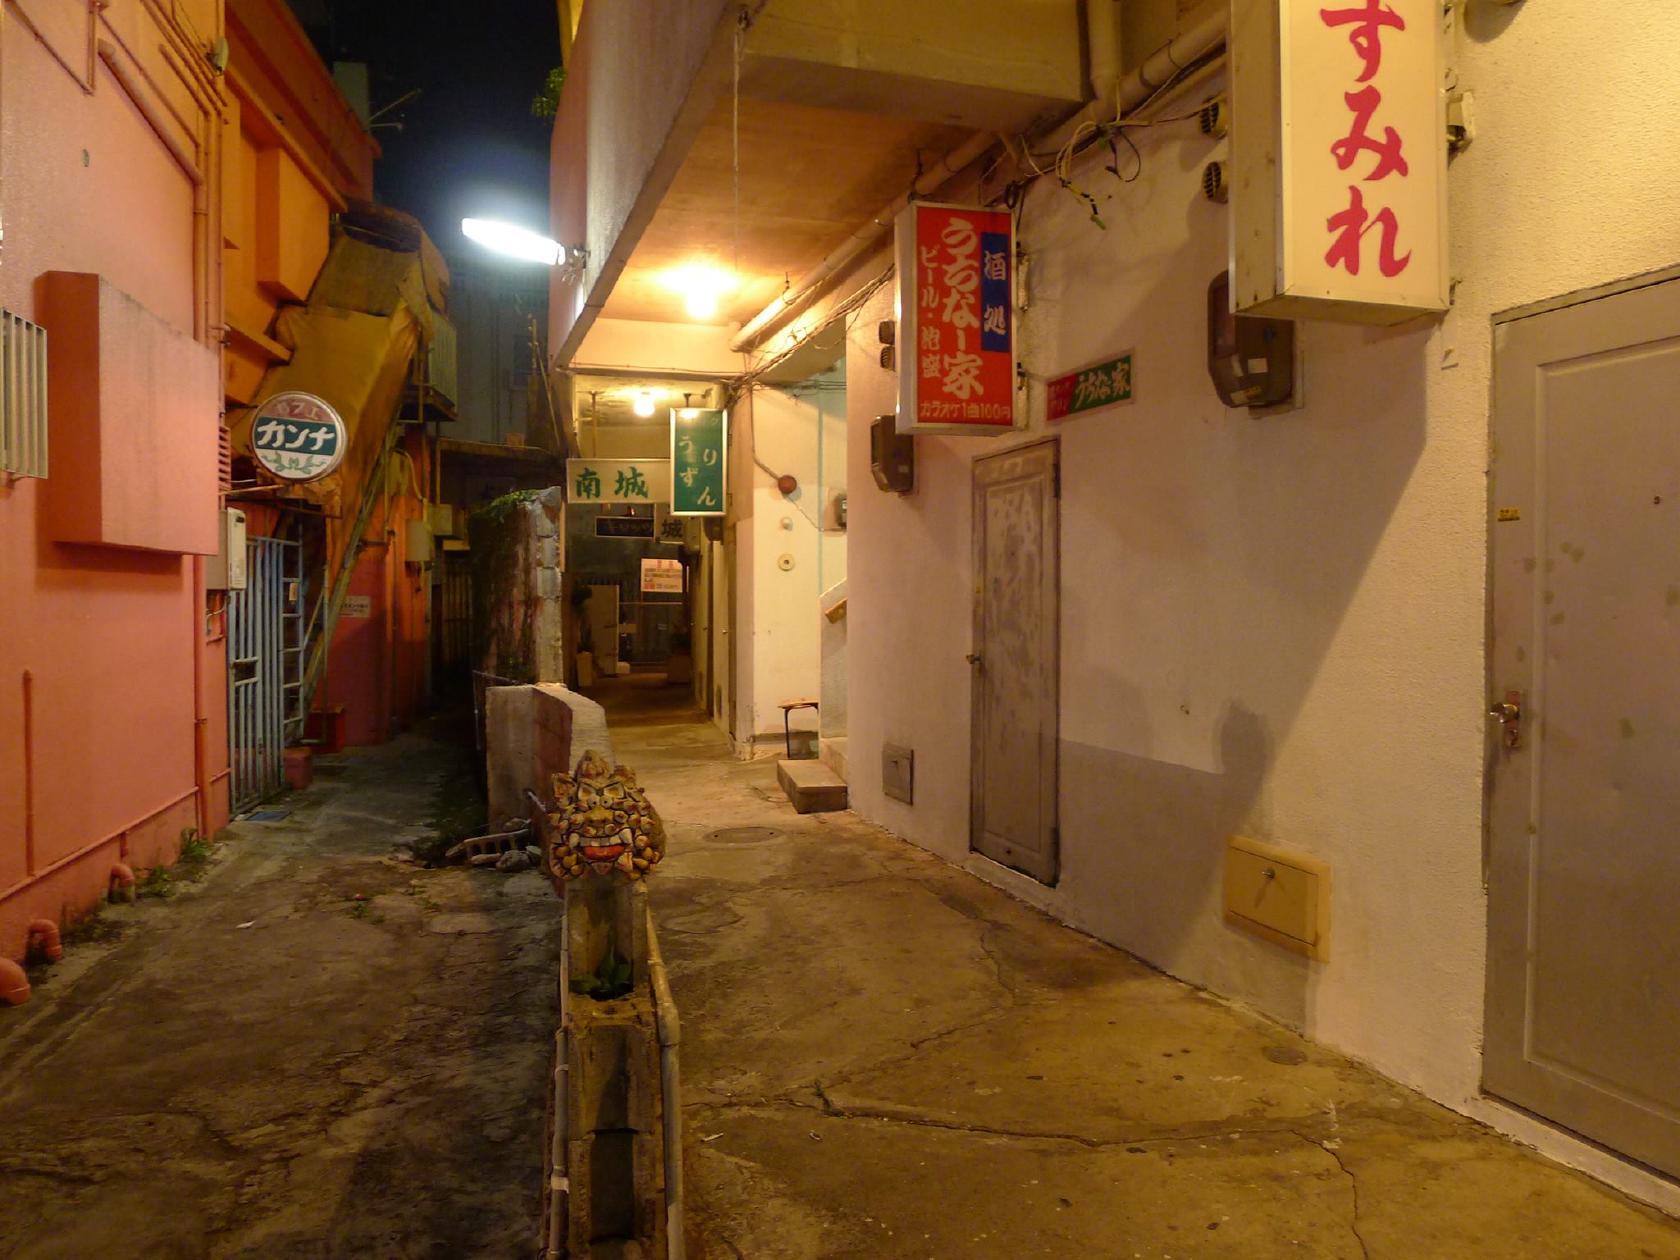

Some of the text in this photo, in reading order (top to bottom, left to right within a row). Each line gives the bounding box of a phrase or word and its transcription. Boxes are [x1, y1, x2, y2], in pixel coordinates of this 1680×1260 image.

[1319, 0, 1412, 278] すみれ
[941, 217, 984, 400] うちなー家
[983, 250, 1007, 336] 酒処
[257, 420, 335, 451] カンナ
[575, 466, 649, 499] 南城
